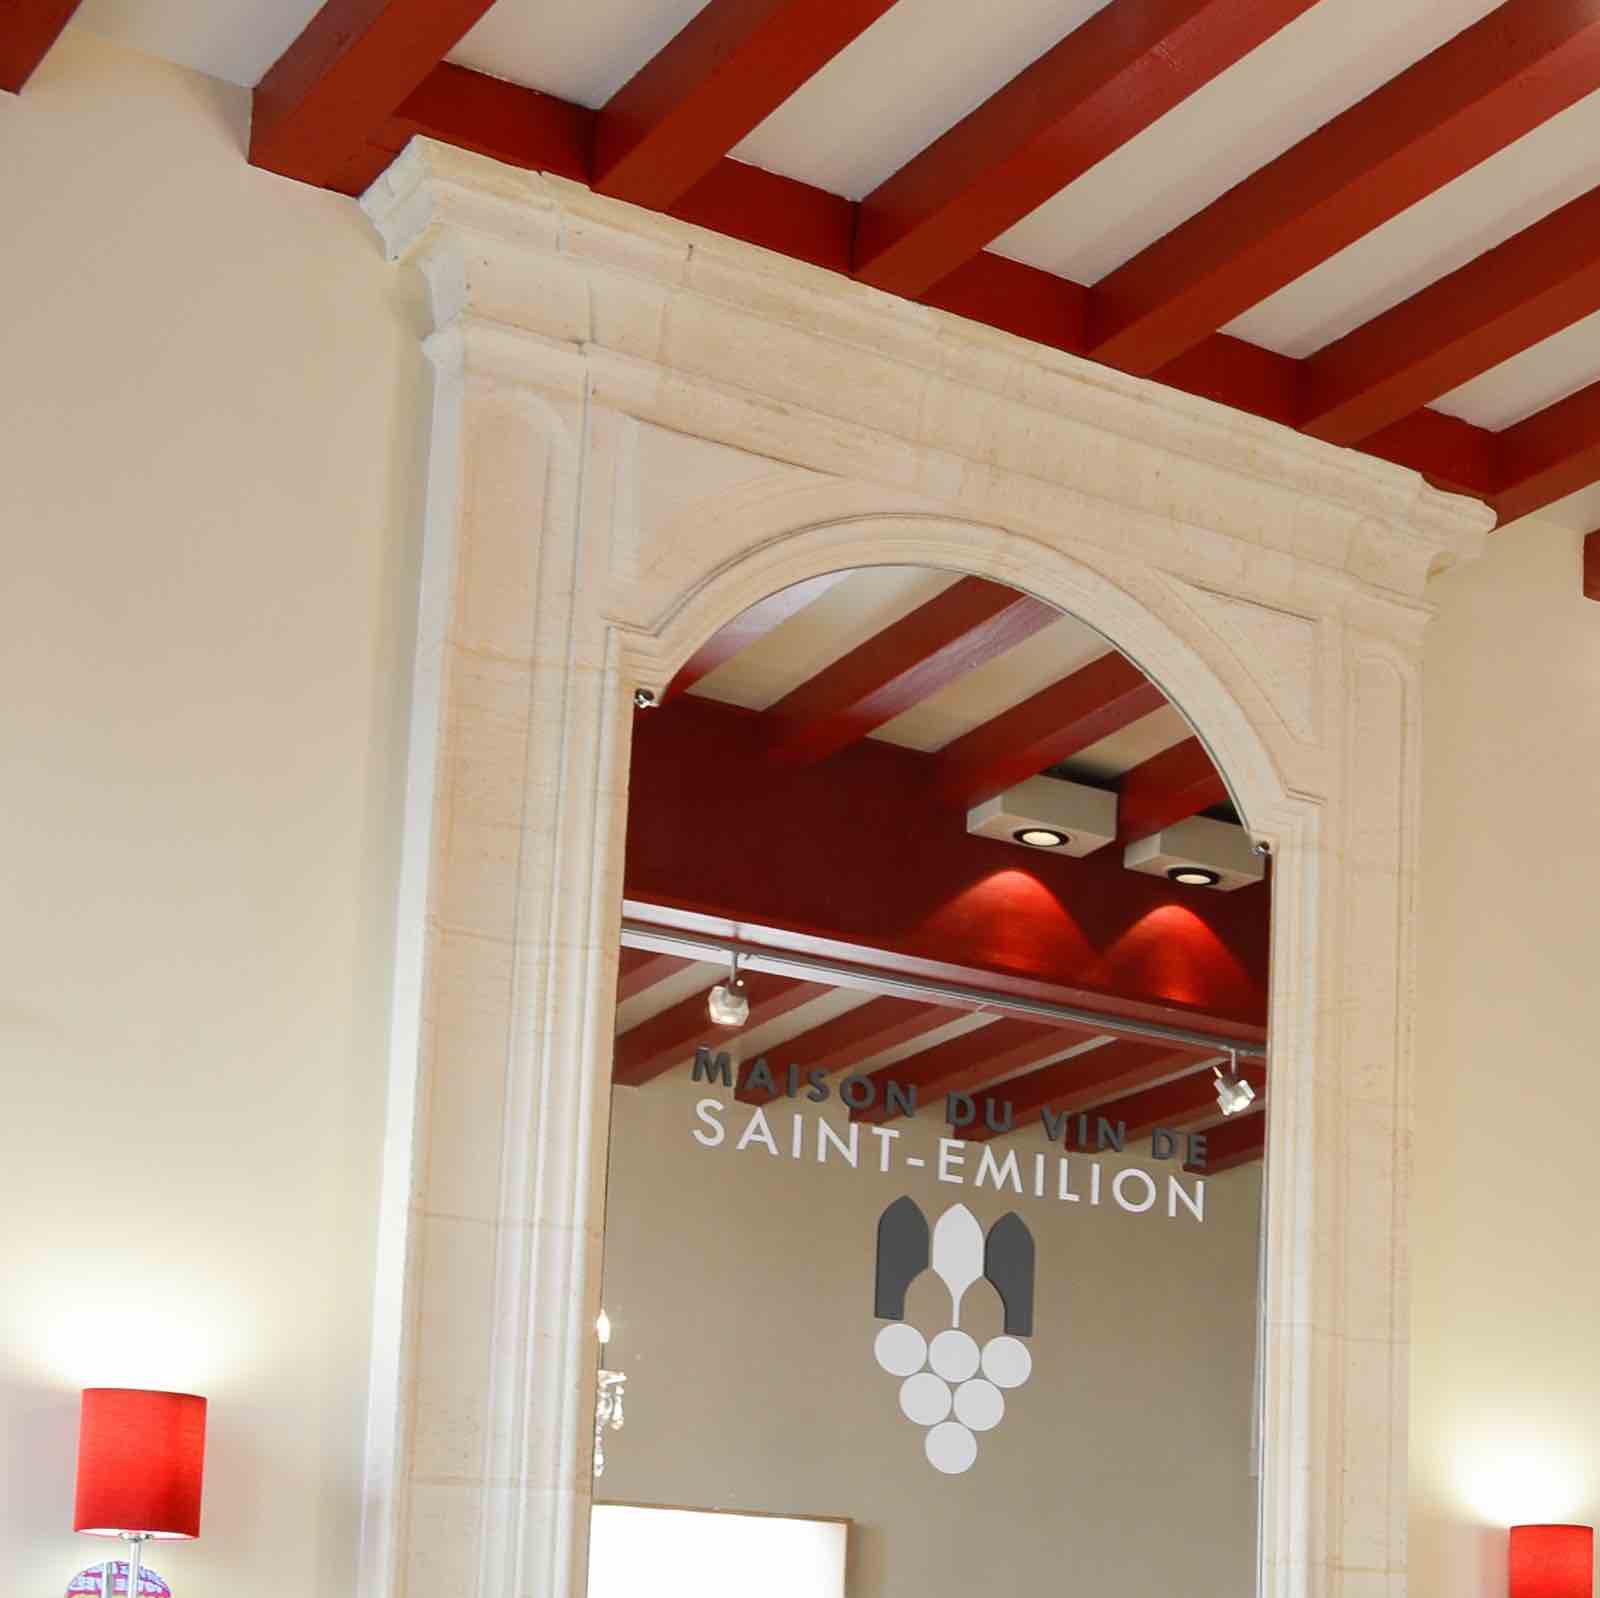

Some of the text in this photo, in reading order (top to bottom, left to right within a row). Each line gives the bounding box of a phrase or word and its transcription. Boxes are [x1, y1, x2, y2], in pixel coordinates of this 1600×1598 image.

[691, 1047, 1208, 1168] MAISON DU VIN DE
[692, 1098, 1207, 1223] SAINT-EMILION
